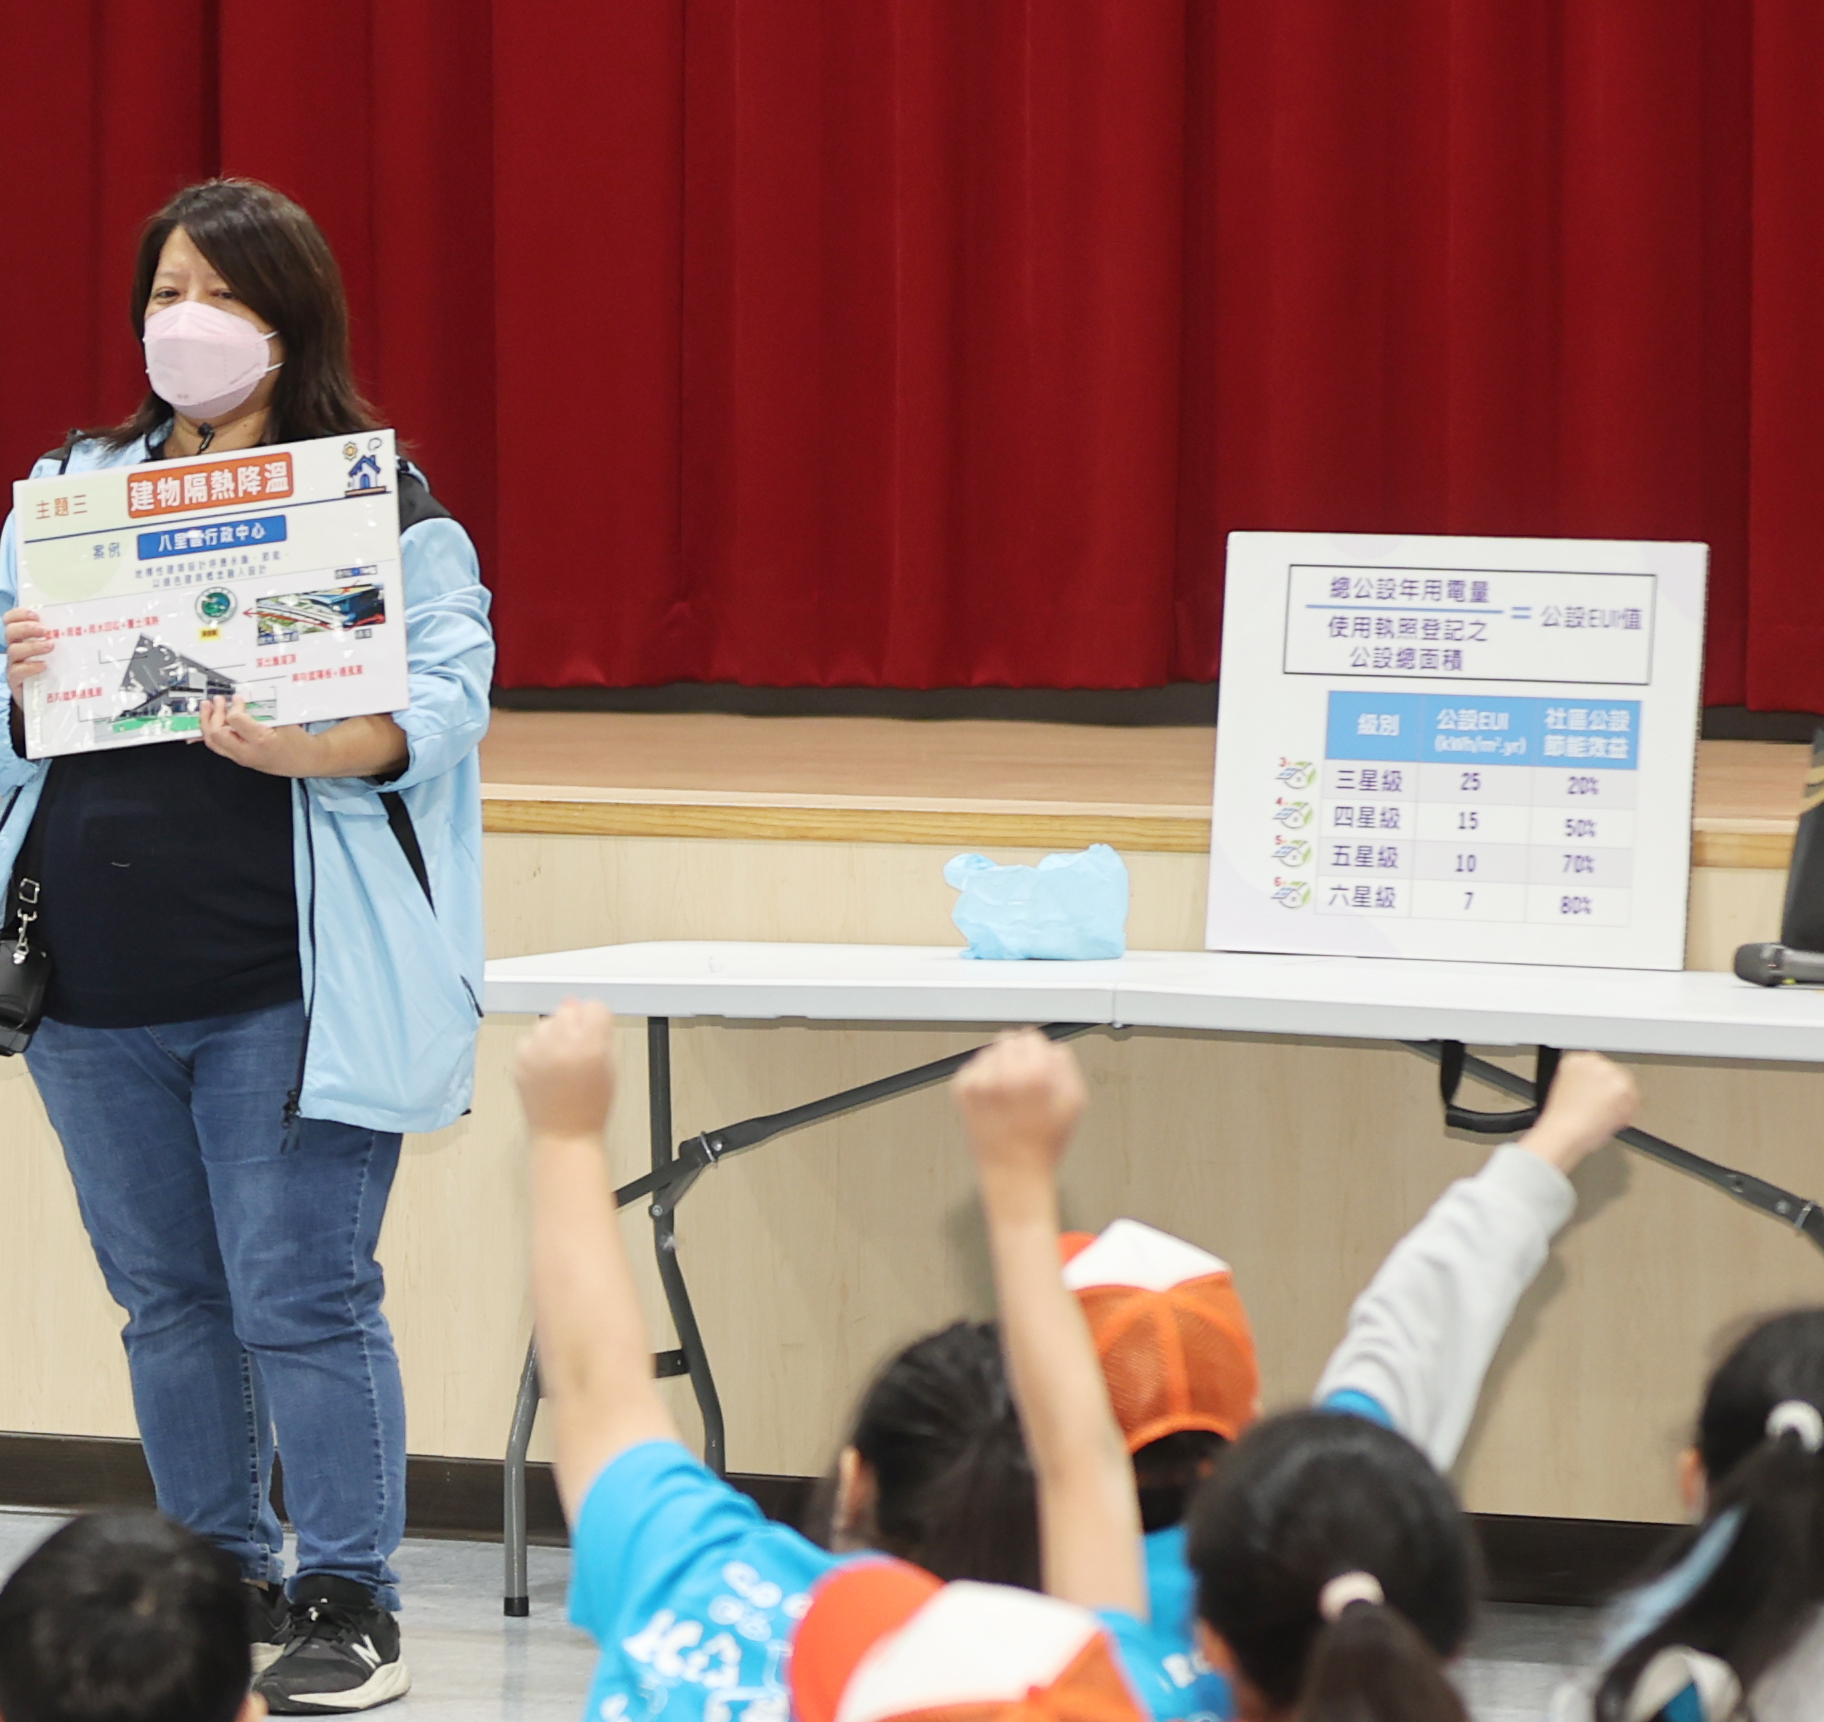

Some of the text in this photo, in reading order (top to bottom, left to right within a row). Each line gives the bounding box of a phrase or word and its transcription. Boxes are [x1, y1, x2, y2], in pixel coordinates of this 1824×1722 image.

[129, 460, 290, 512] 建物隔熱降溫
[35, 494, 88, 520] 主題三
[92, 542, 121, 560] 案例
[1329, 576, 1491, 604] 總公設年用電量
[1327, 614, 1489, 643] 使用執照登記之
[1349, 646, 1464, 672] 公設總面積
[1356, 712, 1401, 737] 級別
[1544, 706, 1631, 732] 社區公設
[1335, 769, 1403, 793] 三星級
[1460, 771, 1482, 791] 25
[1567, 776, 1600, 796] 20%
[1333, 805, 1401, 830] 四星級
[1458, 811, 1480, 830] 15
[1564, 818, 1597, 838] 50%
[1330, 844, 1399, 870] 五星級
[1455, 854, 1477, 873] 10
[1561, 853, 1595, 874] 70%
[1327, 884, 1397, 910] 六星級
[1463, 891, 1475, 911] 7
[1560, 894, 1593, 915] 80%
